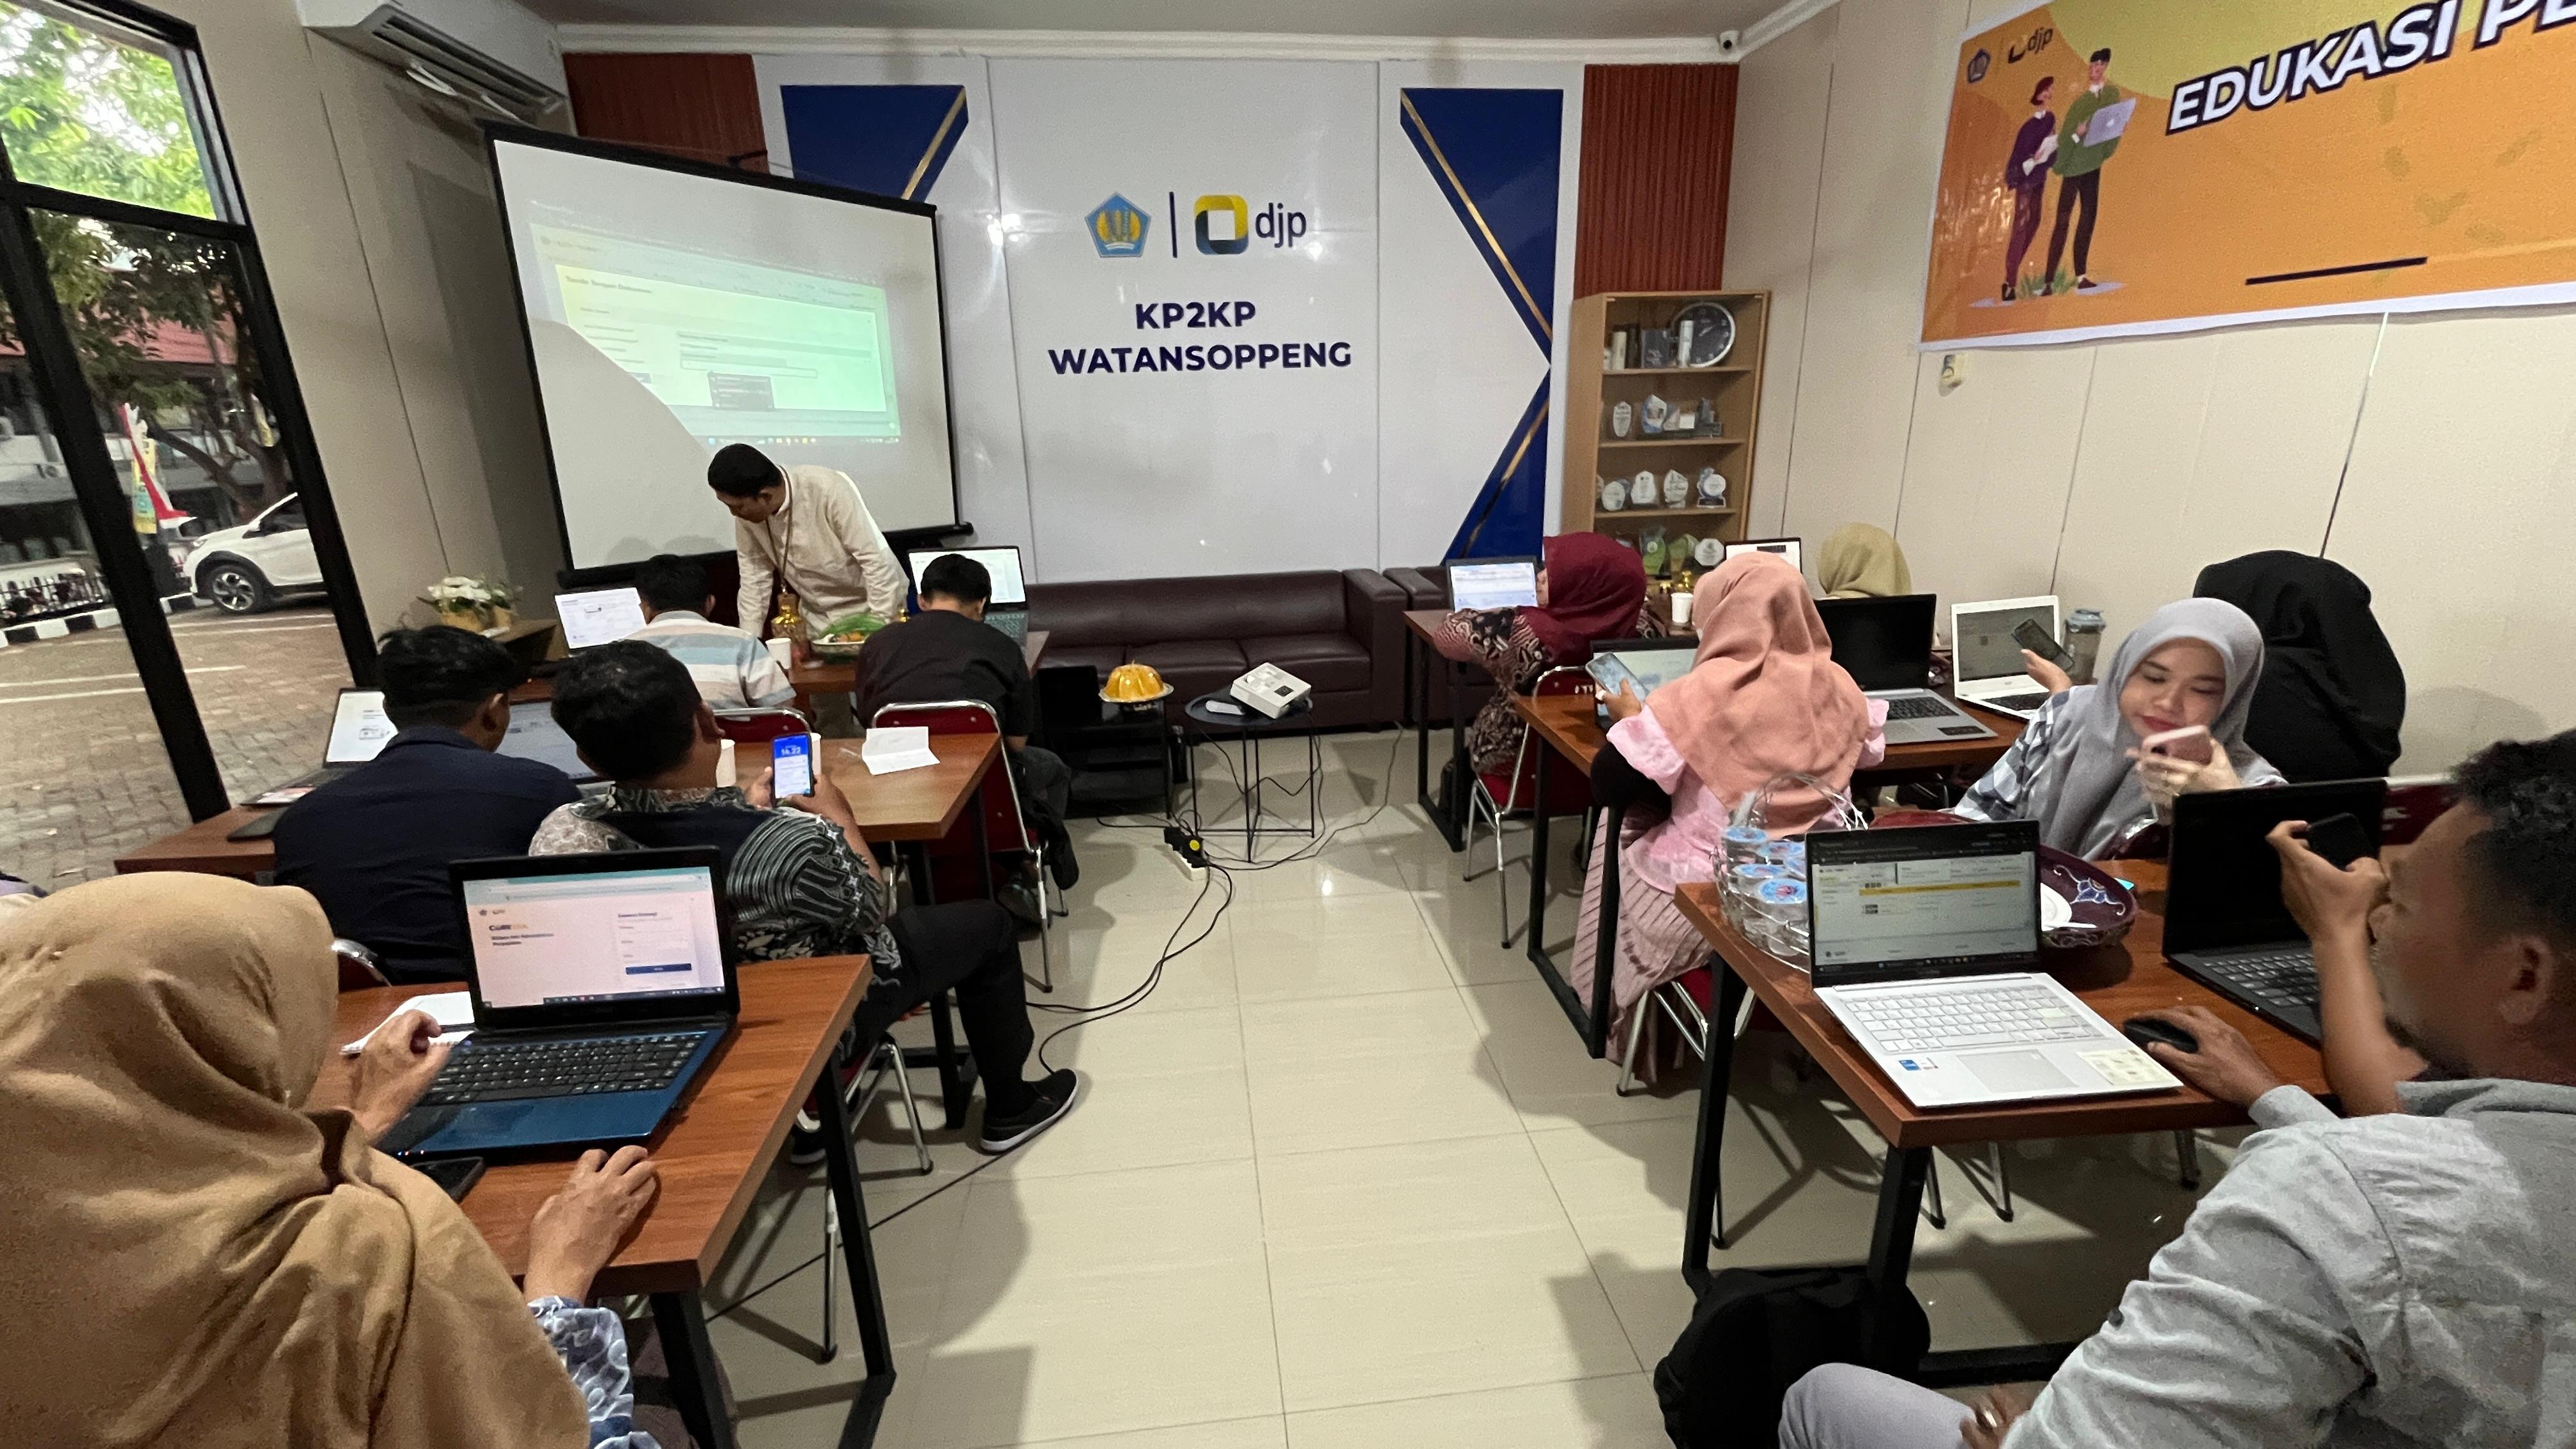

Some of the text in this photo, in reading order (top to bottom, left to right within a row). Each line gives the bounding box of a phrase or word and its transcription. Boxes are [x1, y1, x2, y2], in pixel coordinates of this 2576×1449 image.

[2027, 26, 2053, 55] djp
[2166, 0, 2459, 133] EDUKASI
[1255, 202, 1307, 248] djp
[1135, 301, 1256, 330] KP2KP
[1047, 341, 1352, 375] WATANSOPPENG
